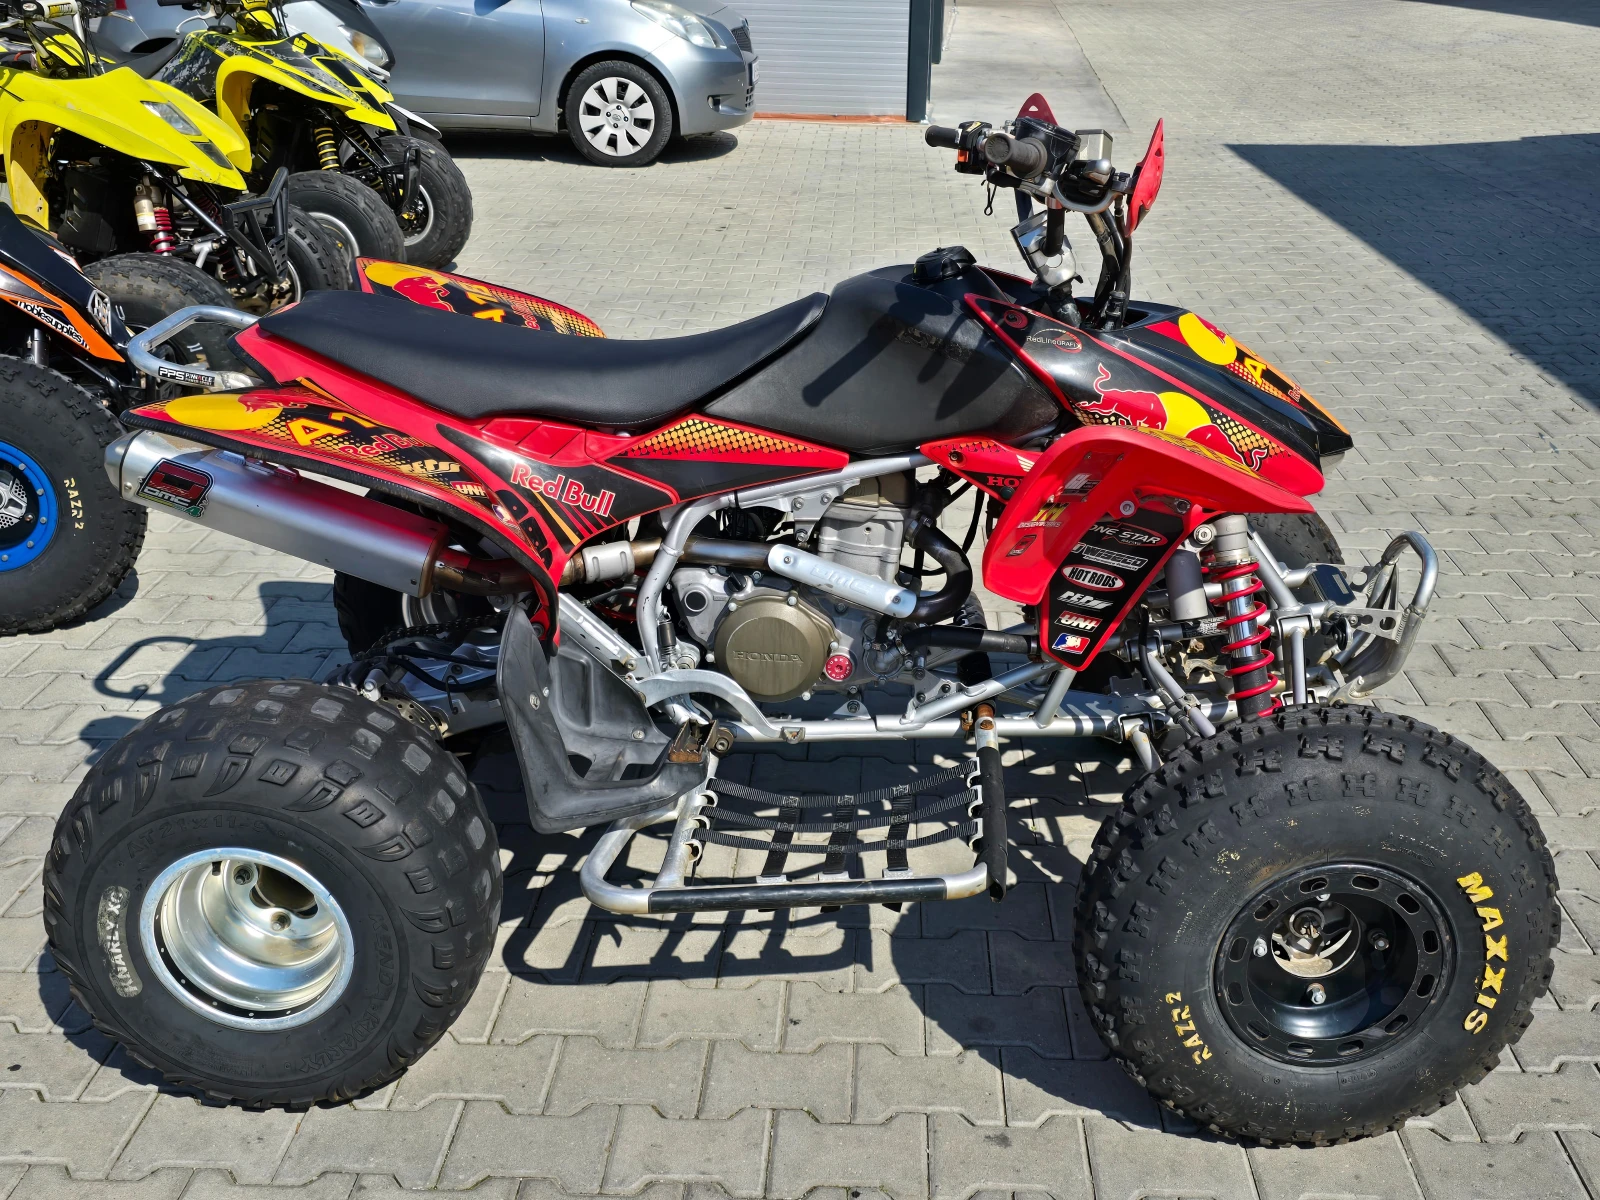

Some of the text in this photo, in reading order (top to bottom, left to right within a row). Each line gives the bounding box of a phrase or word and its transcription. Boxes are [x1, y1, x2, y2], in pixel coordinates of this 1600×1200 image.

[159, 367, 185, 380] PPS
[337, 432, 394, 459] Red
[510, 462, 617, 518] Red Bull
[986, 475, 1021, 488] HO
[143, 486, 192, 507] DMC
[1118, 531, 1161, 545] STAR
[1068, 566, 1119, 588] HOT RODS
[733, 650, 804, 664] HONDA
[1456, 871, 1509, 1036] MAXXIS
